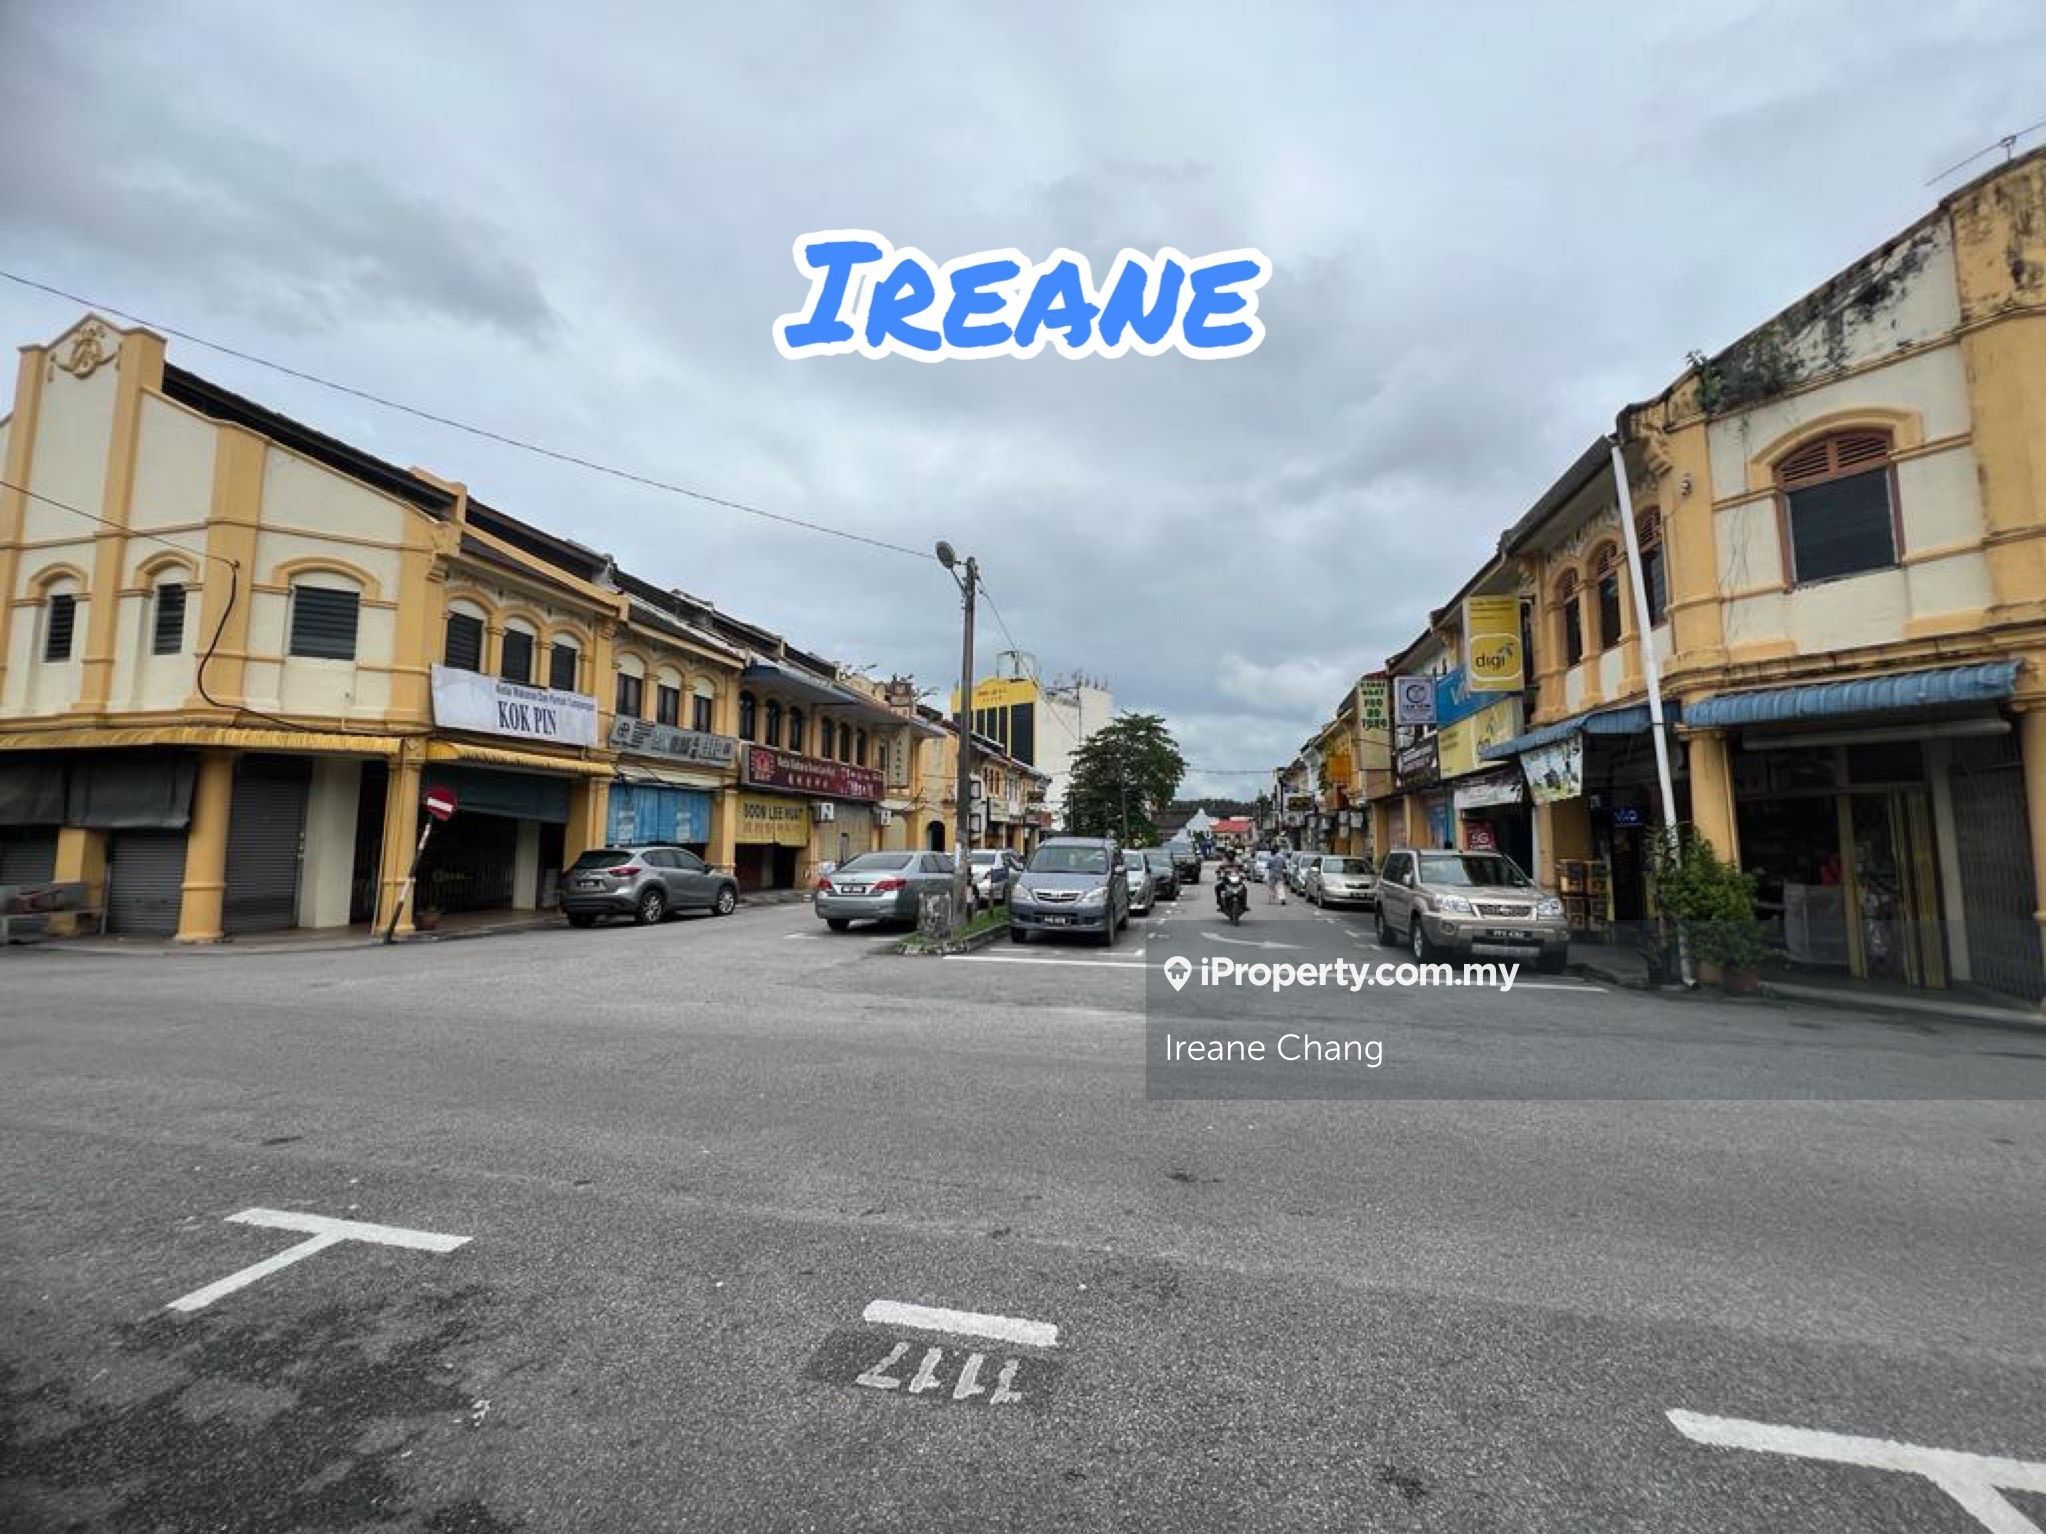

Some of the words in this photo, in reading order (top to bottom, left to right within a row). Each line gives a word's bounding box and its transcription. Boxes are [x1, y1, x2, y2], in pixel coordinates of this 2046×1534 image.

[1475, 654, 1506, 671] digi
[497, 700, 531, 732] KOK
[533, 706, 557, 736] PIN
[768, 805, 784, 820] LEE
